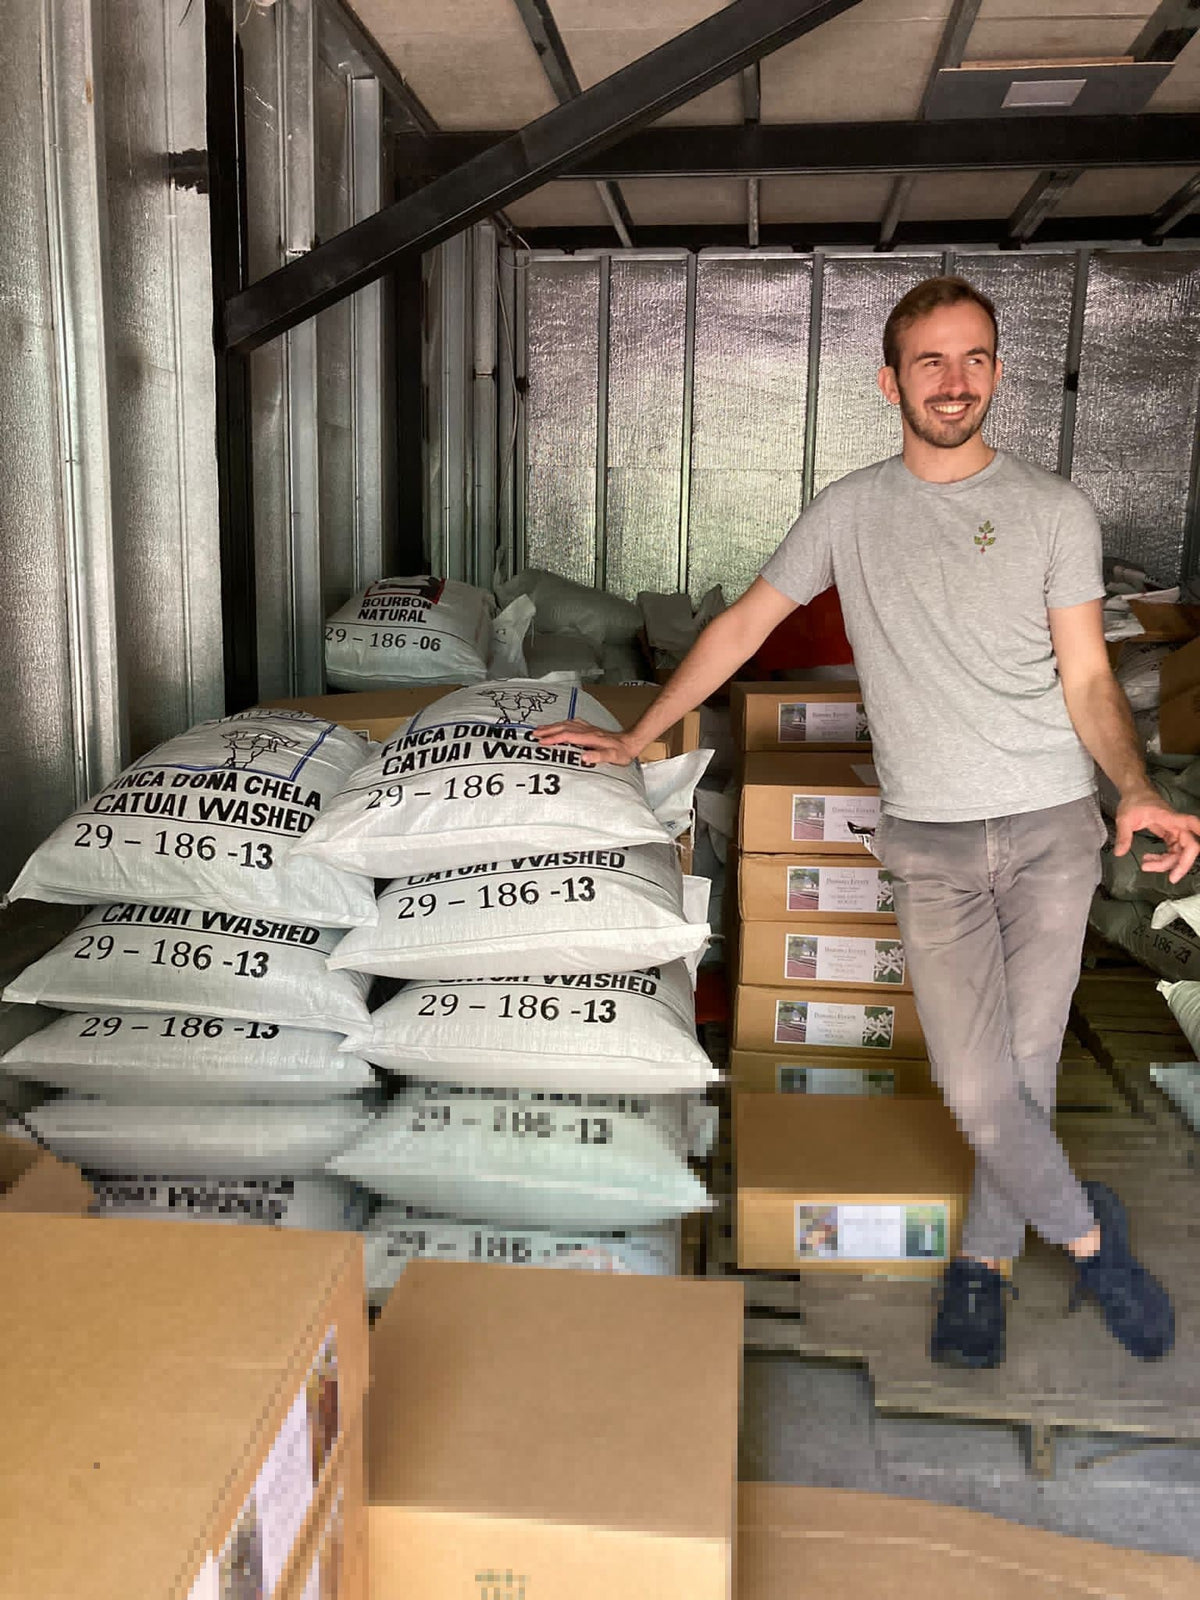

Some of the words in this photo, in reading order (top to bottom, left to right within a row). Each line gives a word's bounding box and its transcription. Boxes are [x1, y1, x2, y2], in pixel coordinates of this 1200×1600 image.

[358, 609, 427, 623] NATURAL
[362, 597, 432, 610] BOURBON
[325, 627, 347, 643] 29
[369, 632, 407, 648] 186
[412, 635, 441, 651] -06
[381, 725, 445, 758] FINCA
[382, 741, 471, 776] CATUAI
[103, 771, 165, 793] INCA
[244, 776, 321, 811] CHELA
[366, 785, 403, 810] 29
[444, 773, 504, 800] 186
[515, 773, 560, 796] -13
[94, 793, 187, 817] CATUAI
[199, 797, 315, 833] WASHED
[74, 823, 113, 849] 29
[154, 831, 216, 861] 186
[227, 841, 273, 870] -13
[510, 850, 625, 870] WASHED
[398, 893, 437, 919] 29
[477, 880, 540, 910] 186
[550, 876, 596, 903] -13
[102, 903, 190, 925] CATUAI
[202, 911, 320, 945] WASHED
[74, 935, 115, 960] 29
[151, 939, 213, 970] 186
[223, 950, 270, 978] -13
[418, 993, 458, 1017] 29
[498, 994, 560, 1021] 186
[570, 999, 617, 1024] -13
[79, 1016, 123, 1038] 29
[160, 1016, 224, 1039] 186
